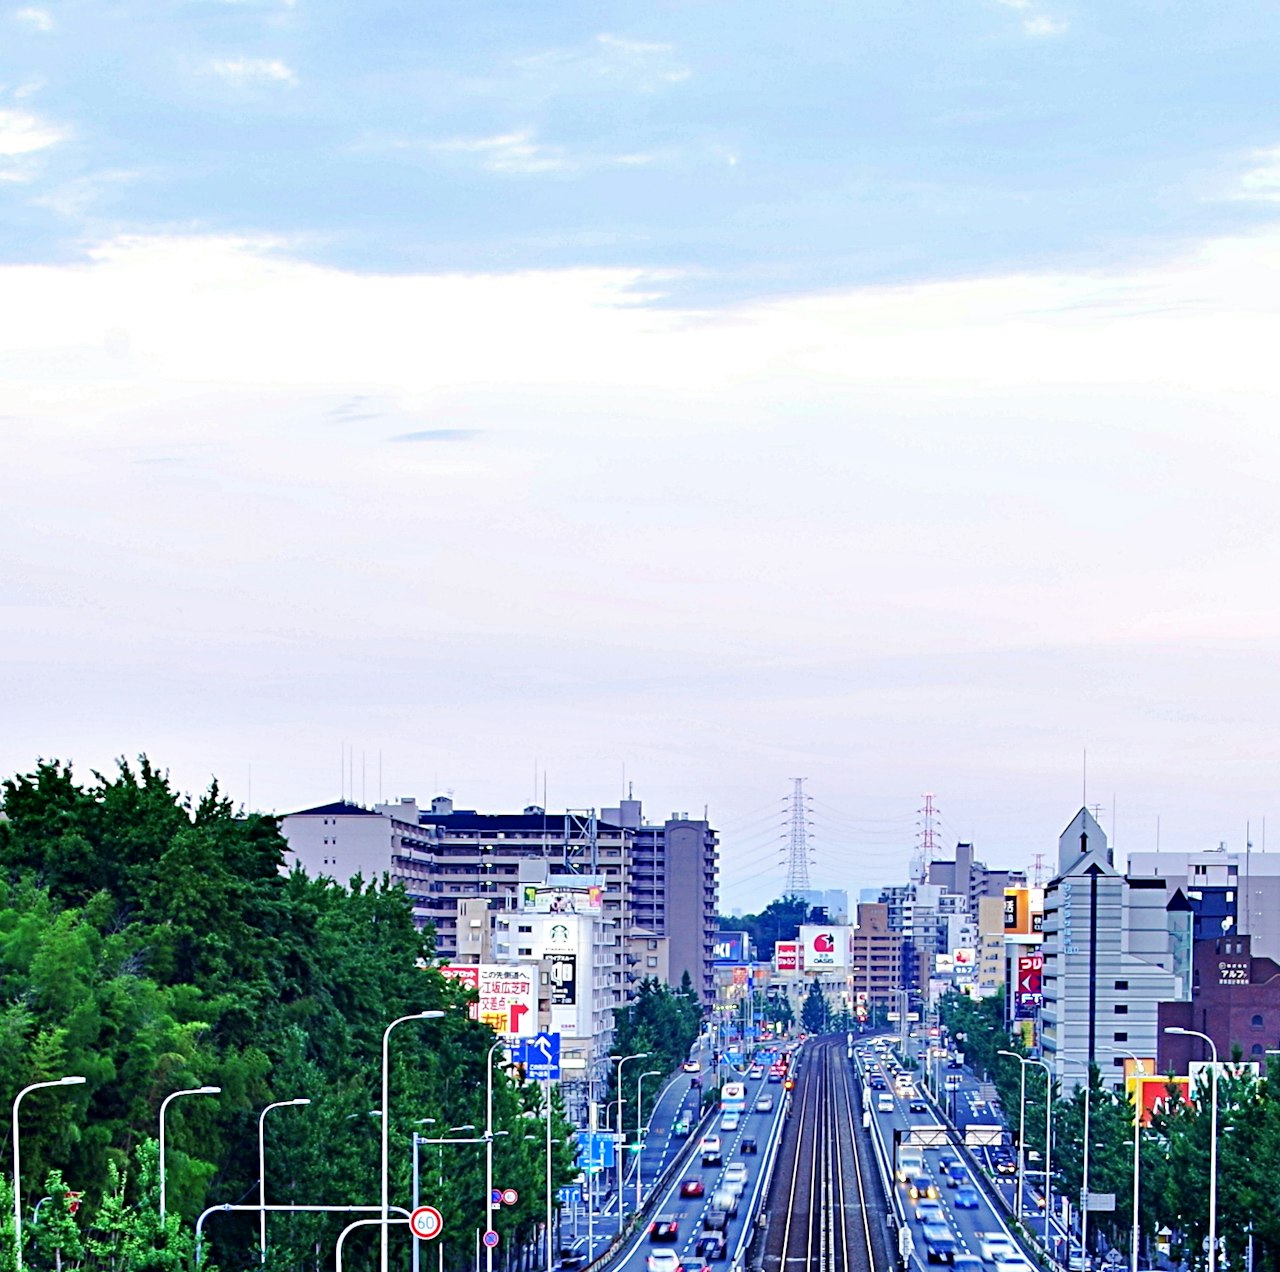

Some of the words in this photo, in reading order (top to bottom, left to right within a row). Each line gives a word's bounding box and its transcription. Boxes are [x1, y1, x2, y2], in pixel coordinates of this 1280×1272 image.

[480, 981, 530, 995] 江坂広芝町
[480, 996, 506, 1010] 交差点
[417, 1216, 435, 1230] 60
